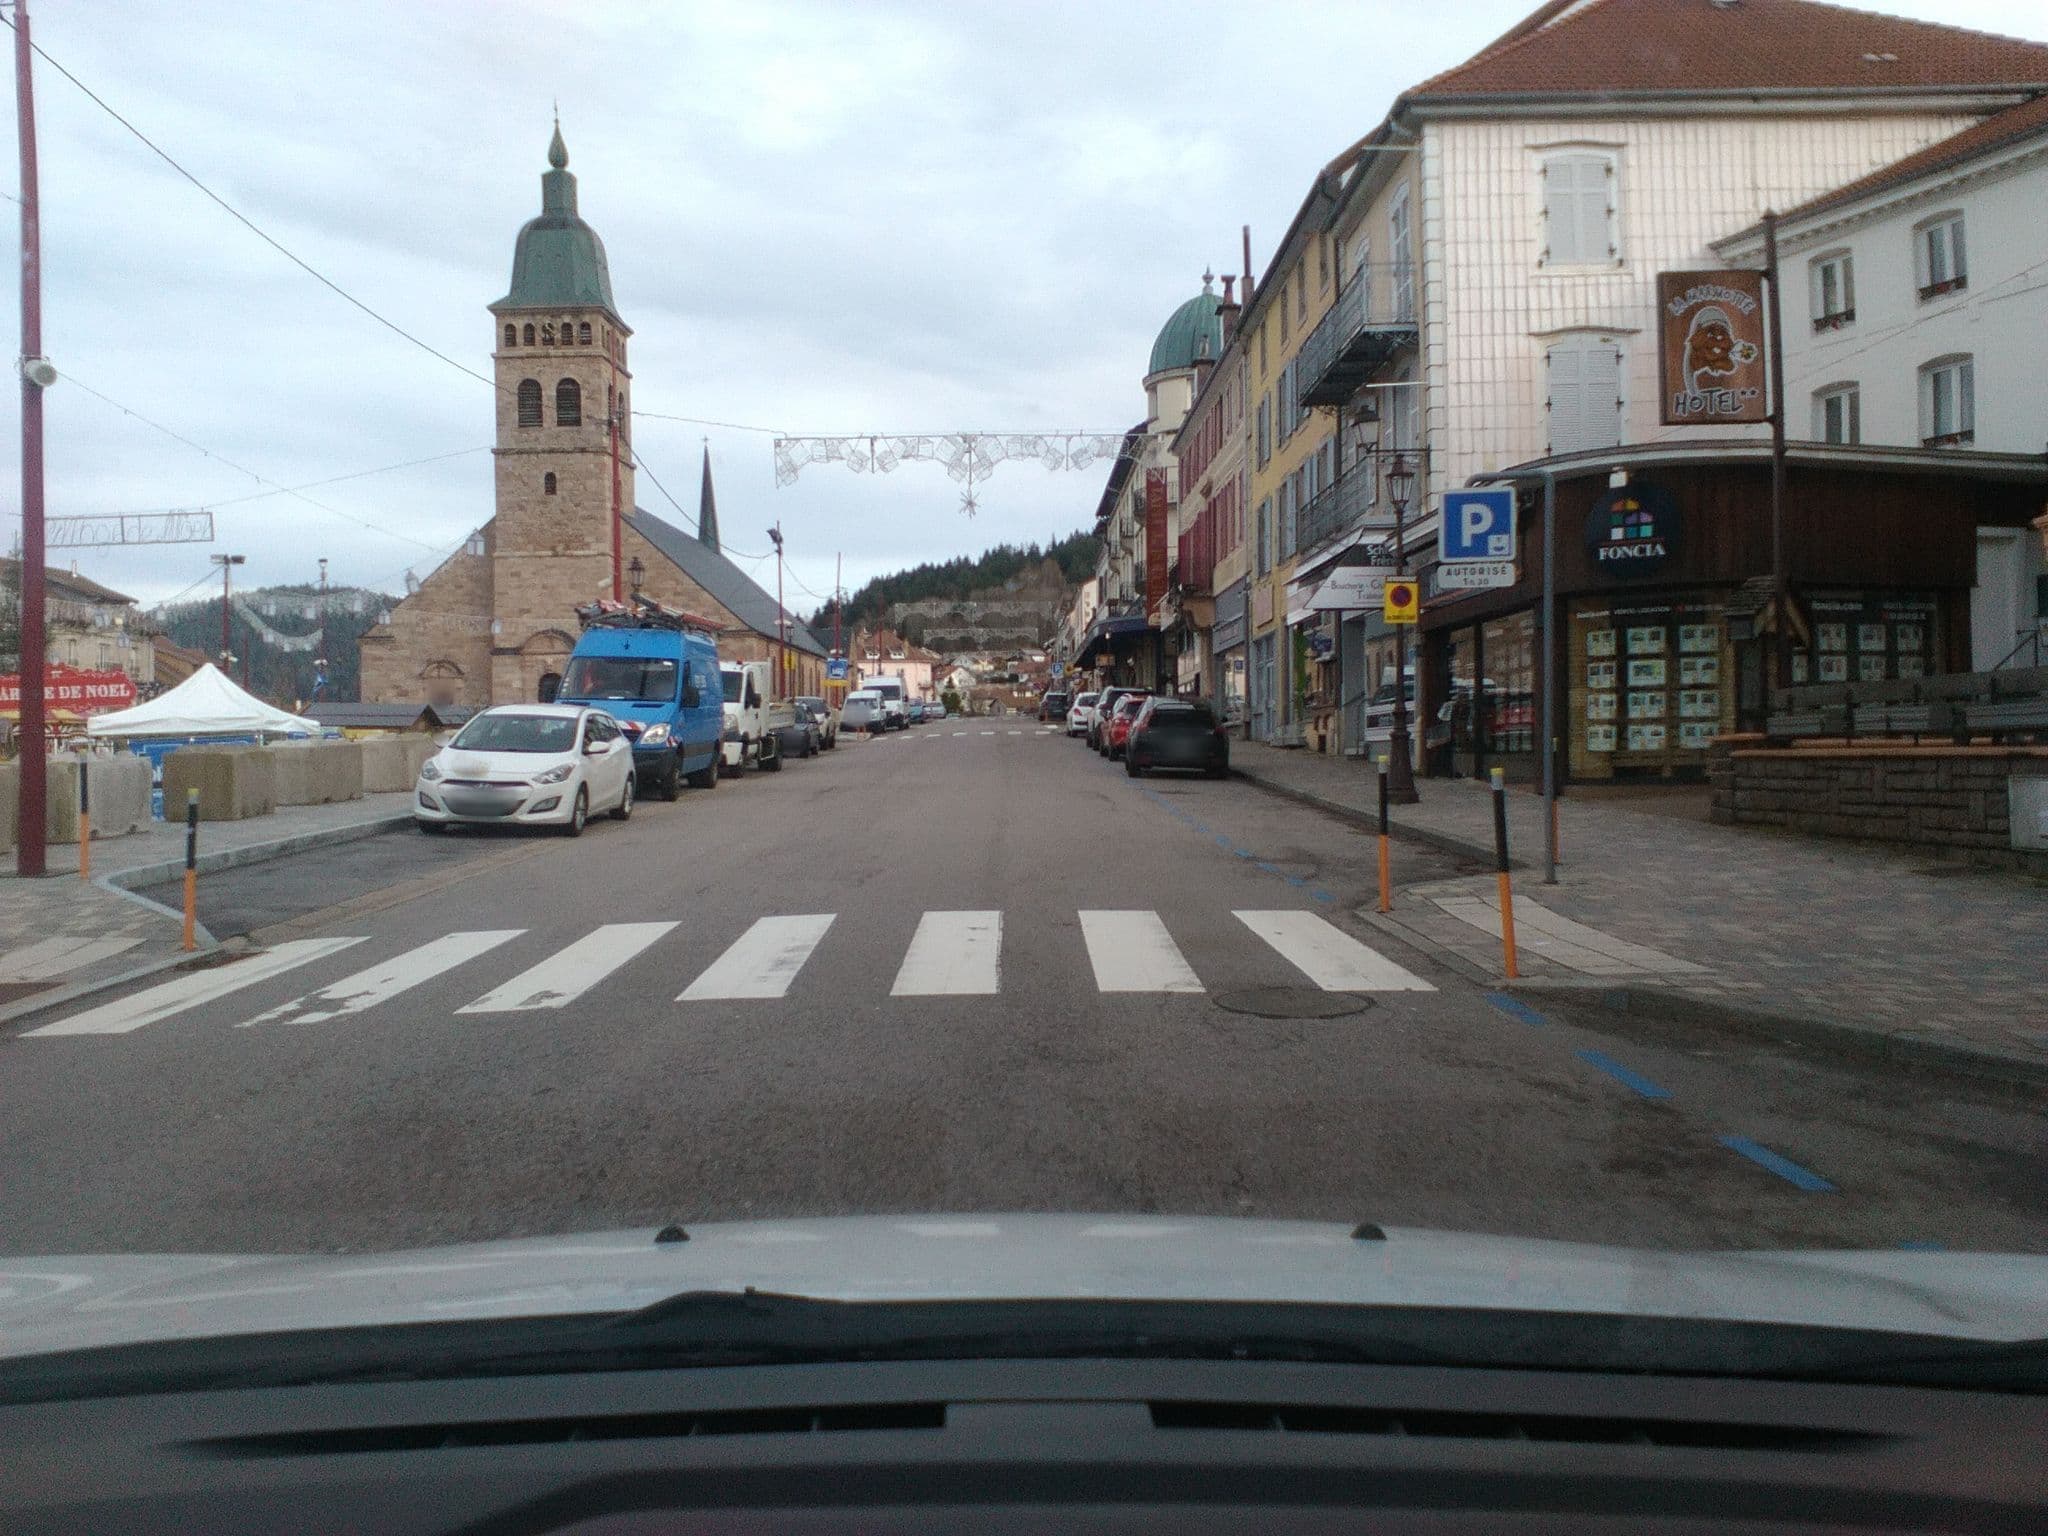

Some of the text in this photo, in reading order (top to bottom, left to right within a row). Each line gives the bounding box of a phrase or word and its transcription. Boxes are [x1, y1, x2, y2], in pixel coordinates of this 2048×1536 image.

[1674, 388, 1744, 417] HOTEL
[1461, 503, 1493, 547] P
[1598, 543, 1666, 560] FONCIA
[58, 685, 81, 699] DE
[85, 683, 130, 698] NOEL
